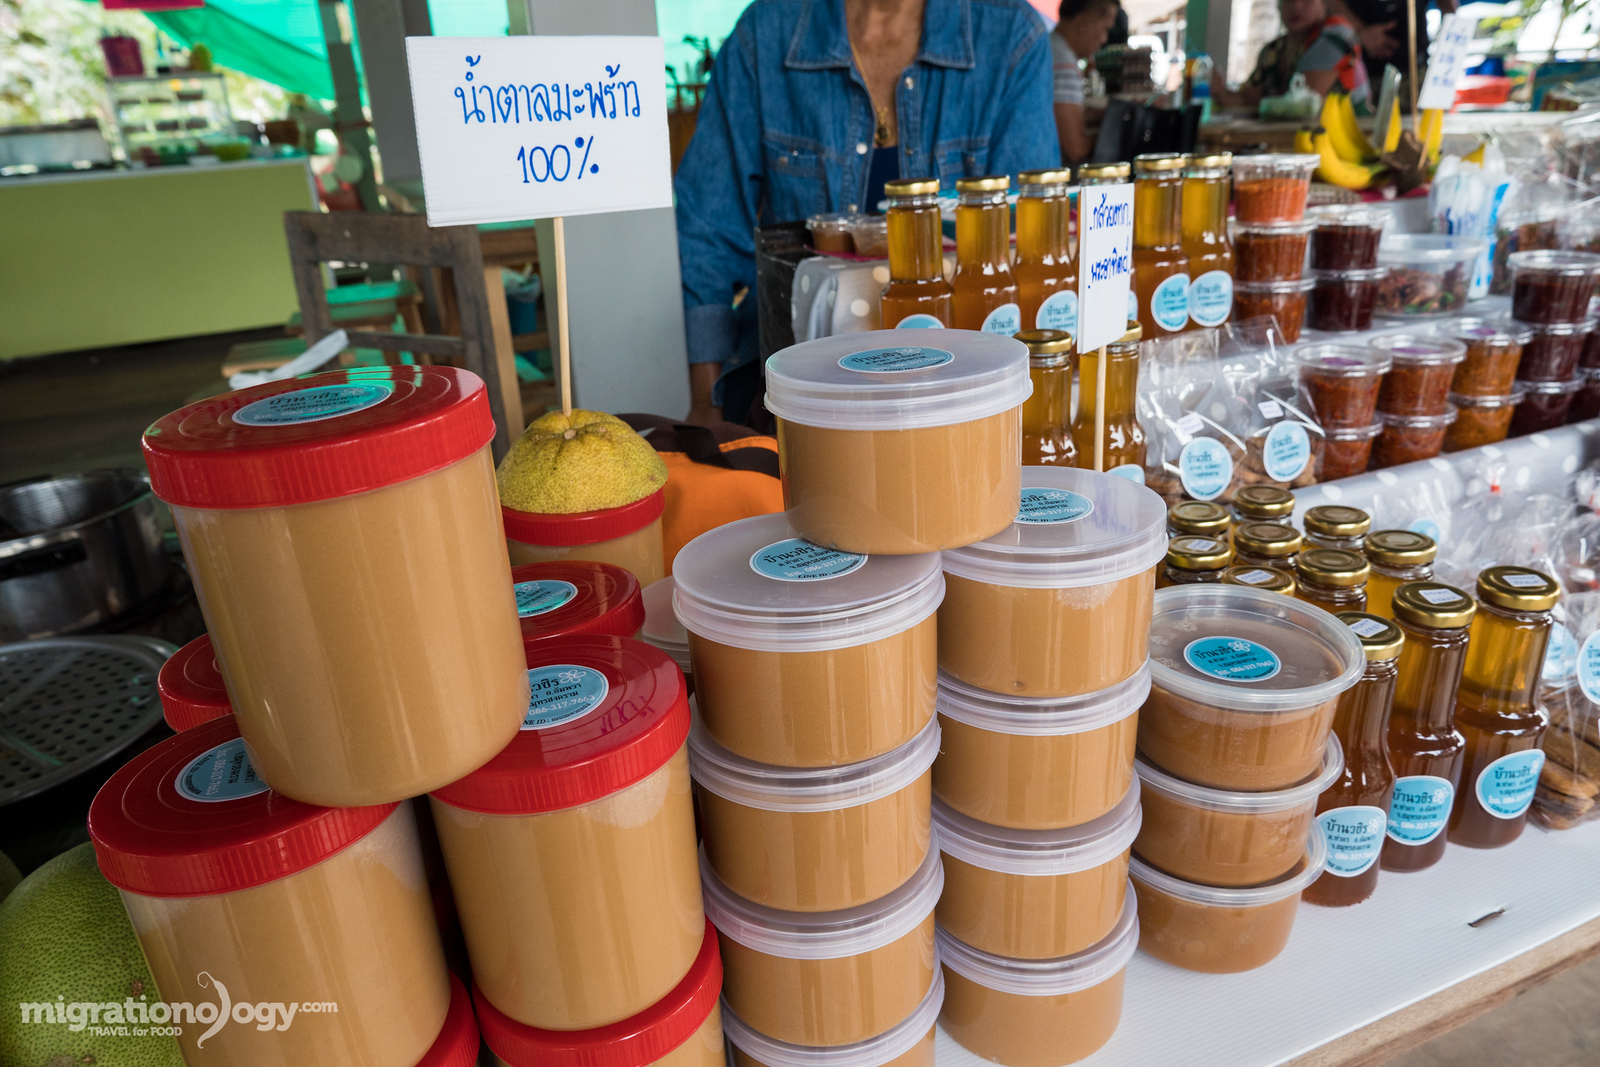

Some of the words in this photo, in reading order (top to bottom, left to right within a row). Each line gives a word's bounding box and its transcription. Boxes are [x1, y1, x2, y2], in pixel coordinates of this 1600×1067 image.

[454, 55, 641, 124] น้ำตาลมะพร้าว
[517, 136, 600, 183] 100%
[763, 546, 816, 564] บ้านวชิร
[804, 554, 859, 573] 086-317-7663
[1194, 646, 1236, 659] บ้านวชิร
[546, 683, 581, 696] อ.อัมพวา
[529, 695, 595, 716] 086-317-7663
[1494, 765, 1530, 779] บ้านวชิร
[1392, 788, 1433, 804] บ้านวชิร
[1326, 819, 1368, 834] บ้านวชิร
